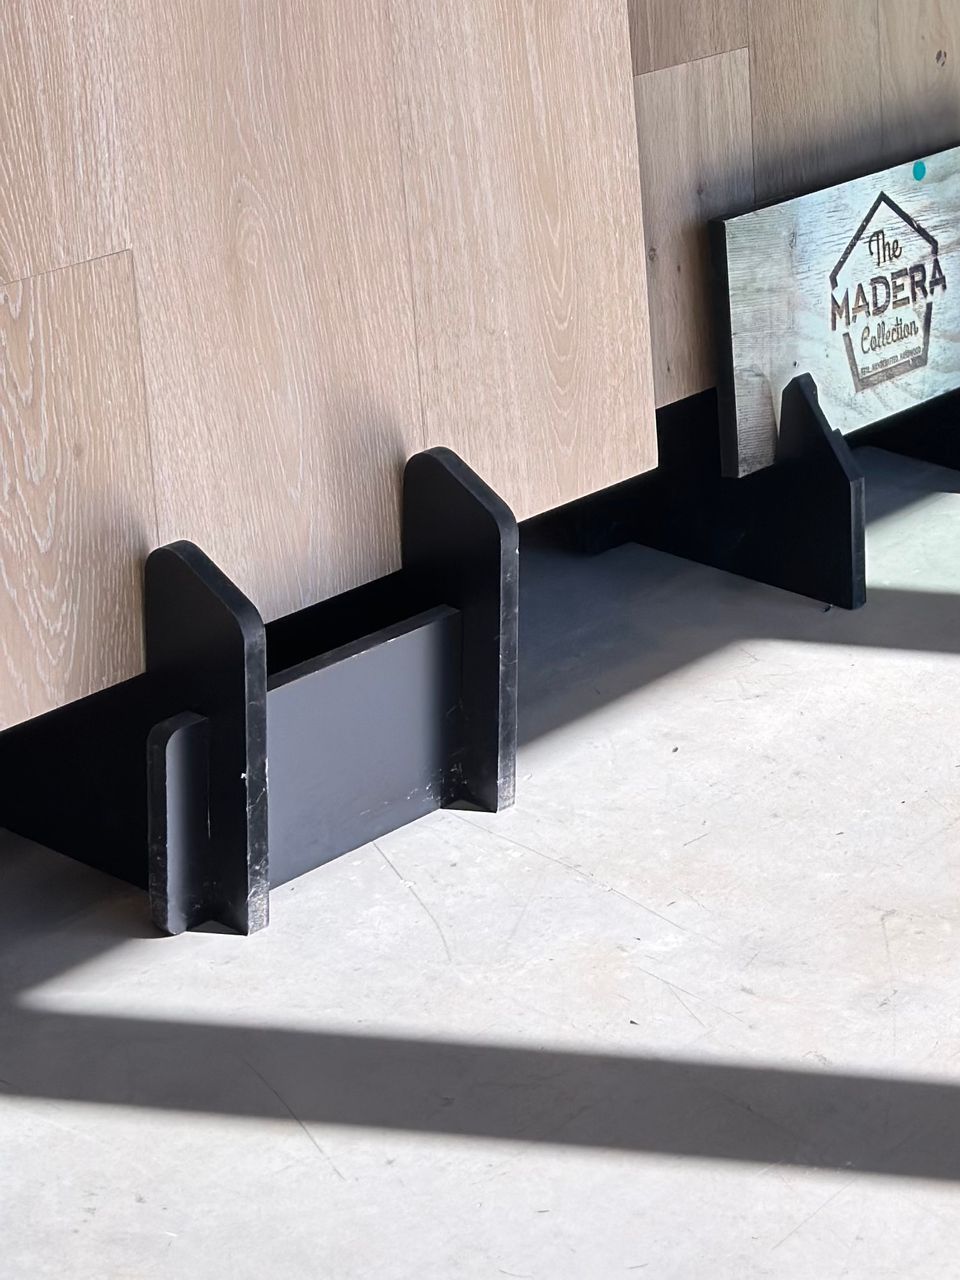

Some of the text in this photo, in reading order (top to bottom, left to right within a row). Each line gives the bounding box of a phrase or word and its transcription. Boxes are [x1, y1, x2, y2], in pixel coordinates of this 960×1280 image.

[867, 229, 903, 267] The
[831, 257, 948, 332] MADERA
[860, 316, 920, 355] Collection
